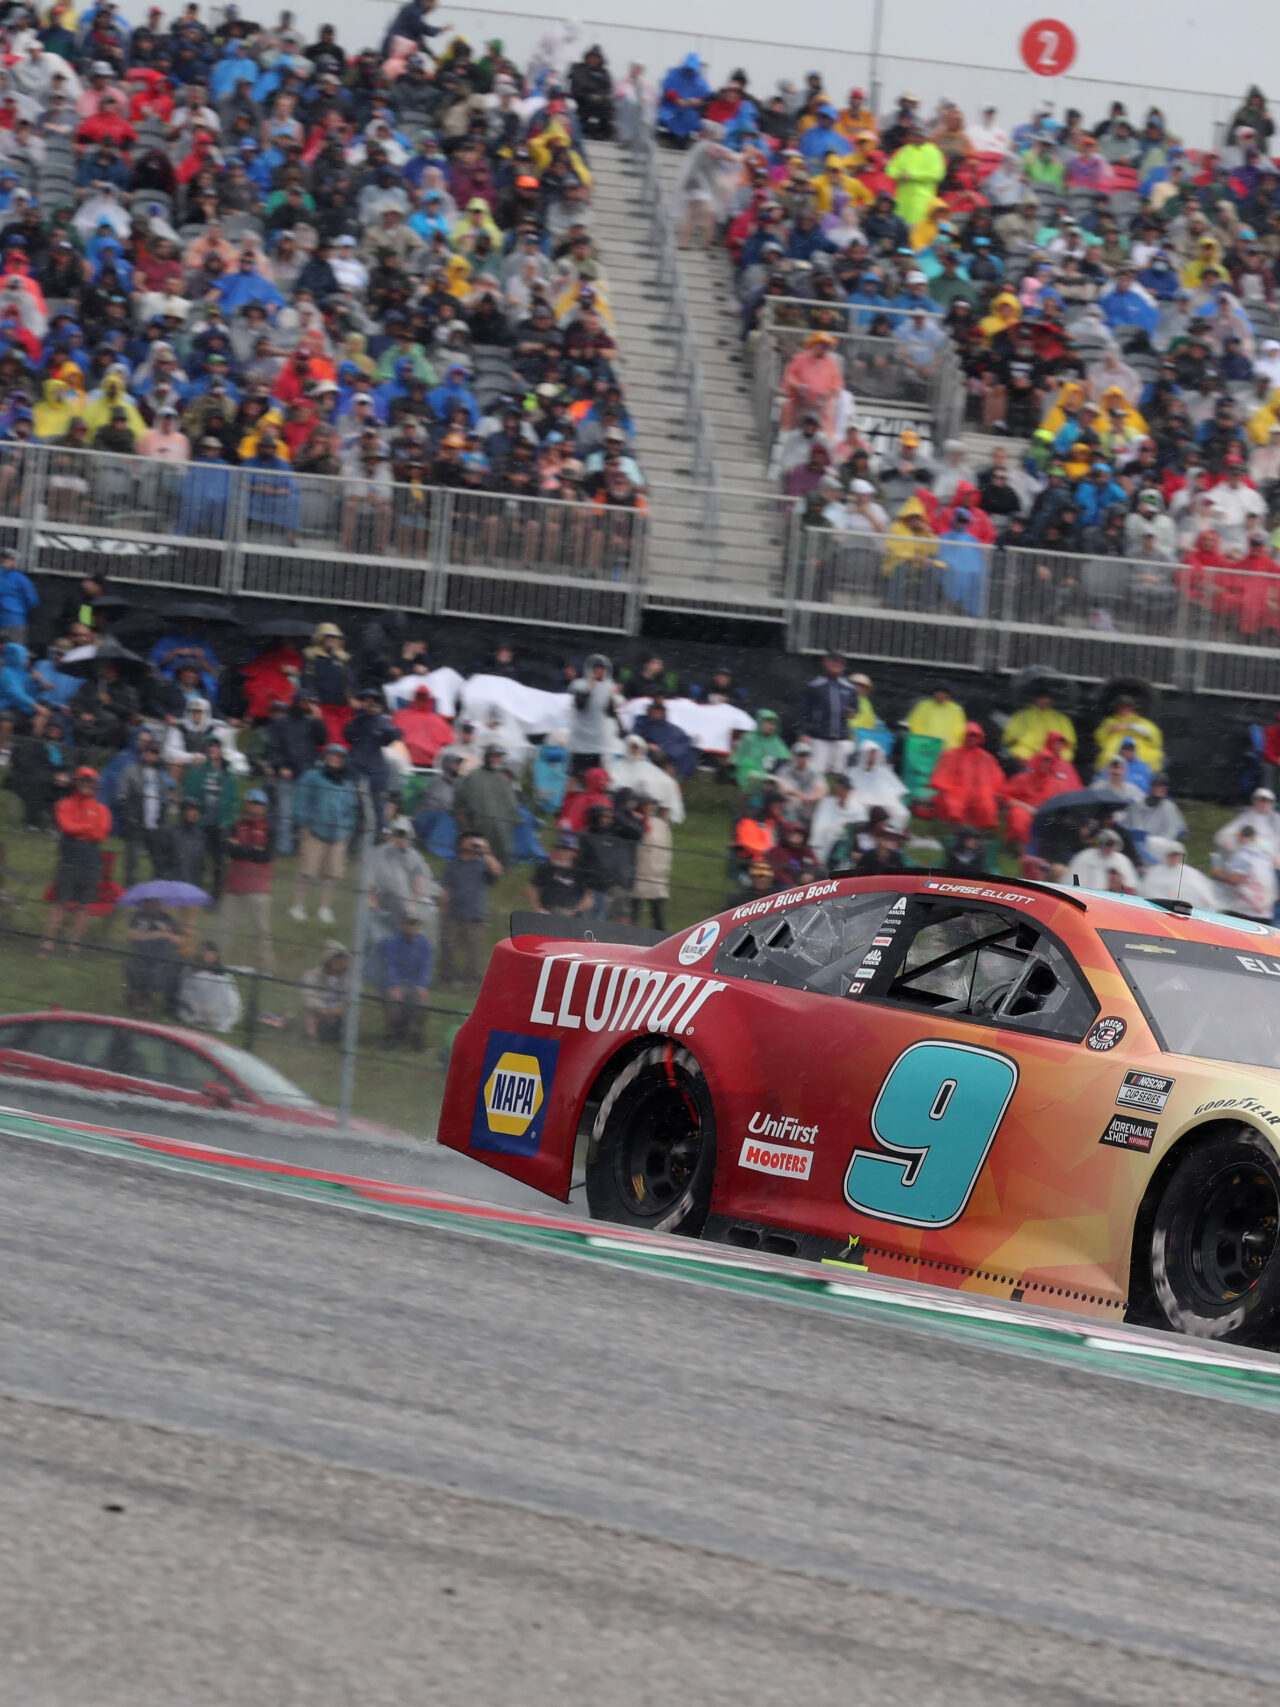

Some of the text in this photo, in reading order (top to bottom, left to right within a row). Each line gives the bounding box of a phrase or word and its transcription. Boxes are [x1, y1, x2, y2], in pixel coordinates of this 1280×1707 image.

[1037, 30, 1060, 66] 2
[732, 880, 840, 920] Kelley Blue Book
[938, 883, 1035, 905] CHASE ELLIOTT
[1100, 1019, 1124, 1033] NASCAR
[1088, 1036, 1114, 1050] SALUTES
[491, 1073, 535, 1115] NAPA
[1138, 1076, 1166, 1091] NASCAR
[1124, 1089, 1161, 1104] CUP SERIES
[748, 1111, 819, 1144] UniFirst
[843, 1038, 1020, 1231] 9
[1109, 1118, 1155, 1139] ADRENALINE
[746, 1146, 808, 1173] HOOTERS
